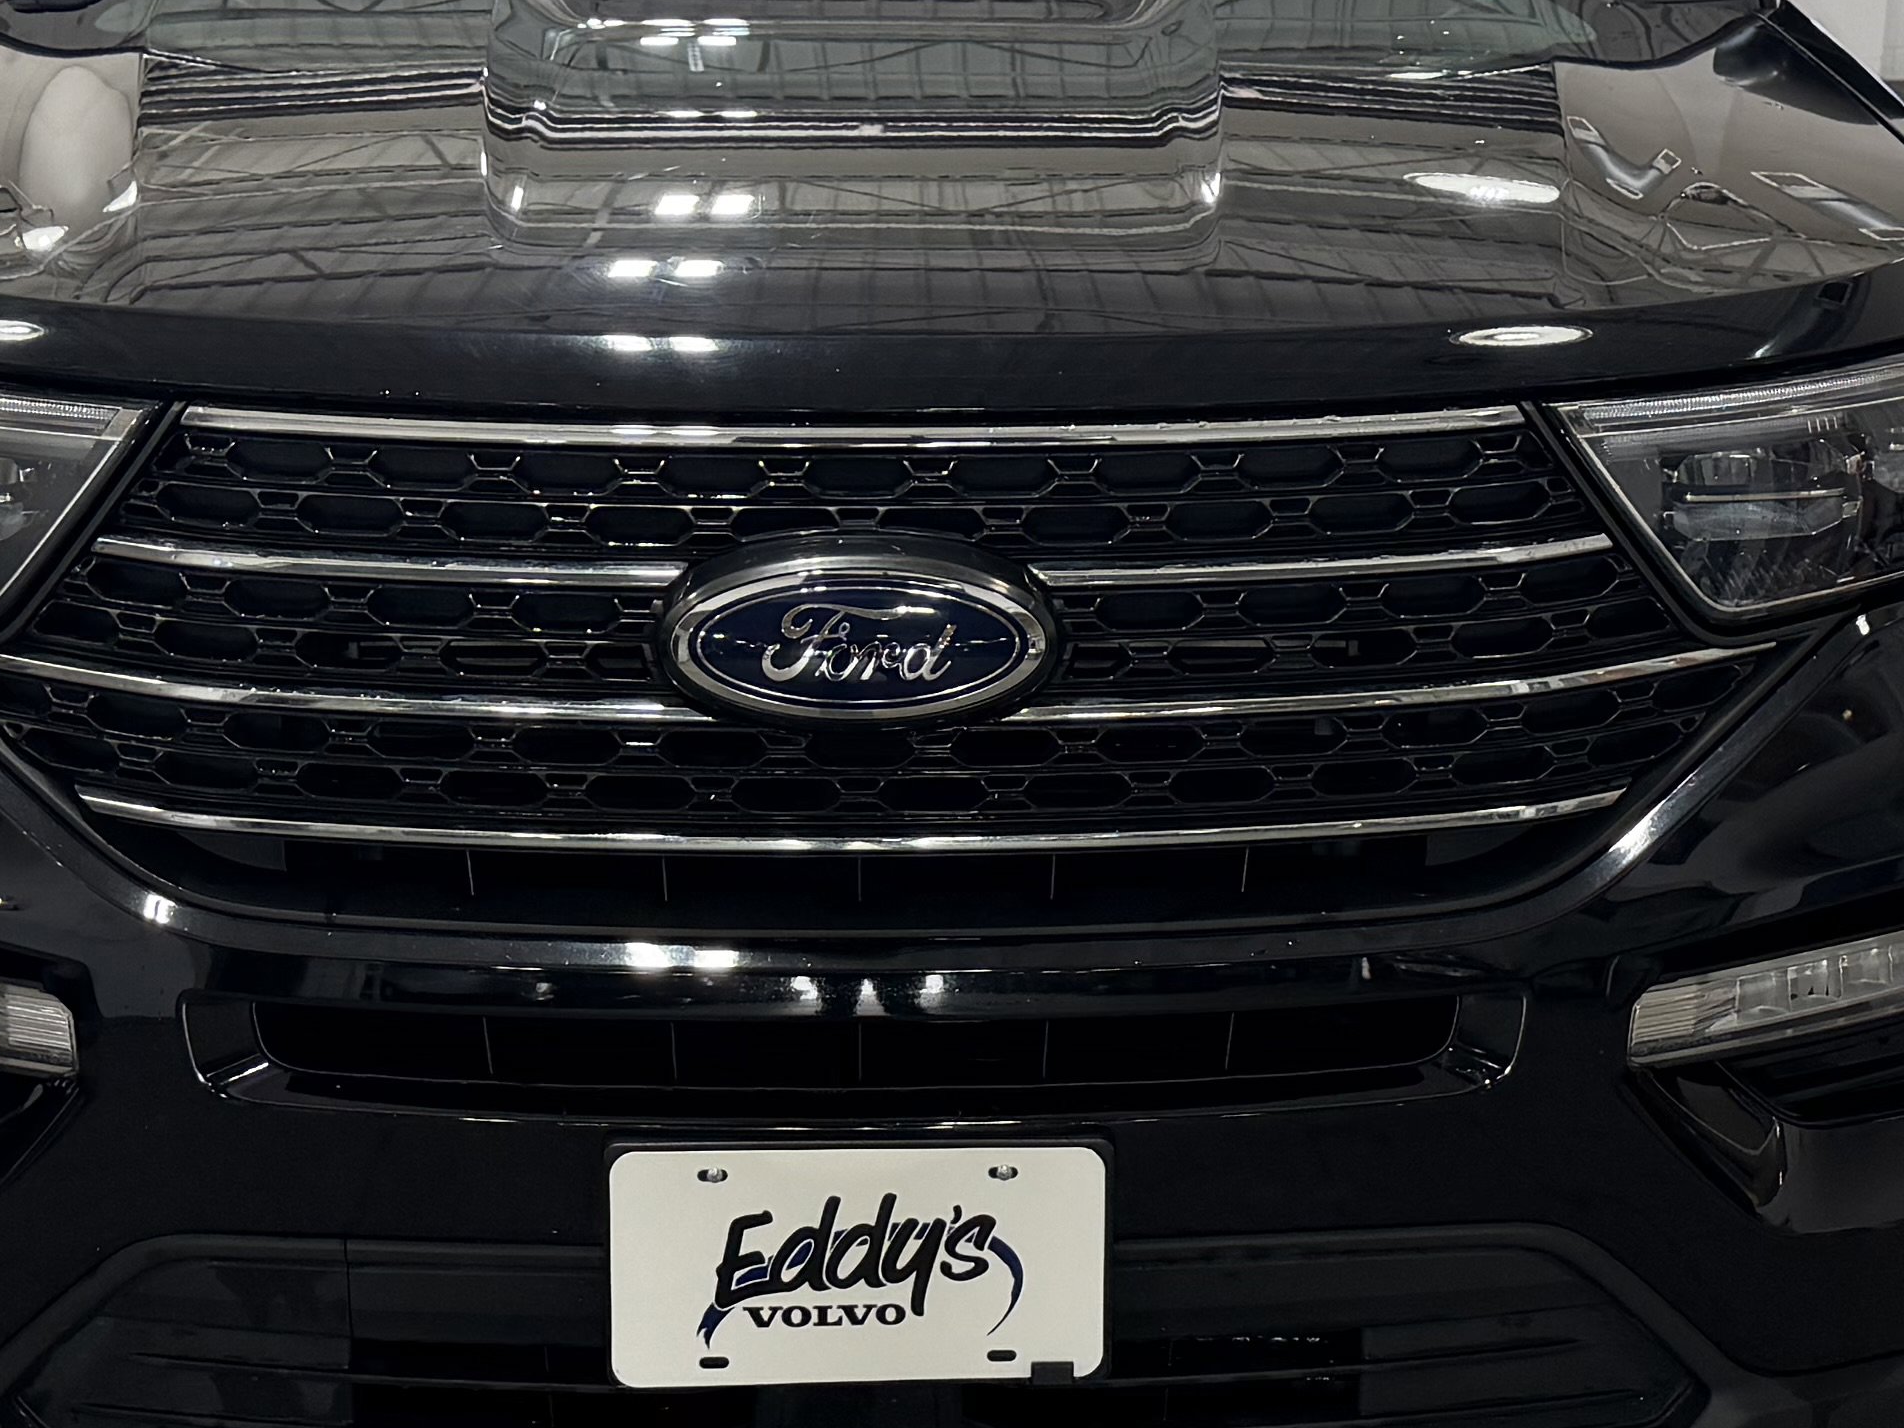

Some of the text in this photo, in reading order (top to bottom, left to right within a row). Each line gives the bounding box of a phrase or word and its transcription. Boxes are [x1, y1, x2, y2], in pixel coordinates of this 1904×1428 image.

[762, 602, 956, 682] Ford
[714, 1192, 997, 1317] Eddy's
[742, 1302, 907, 1329] VOLVO
